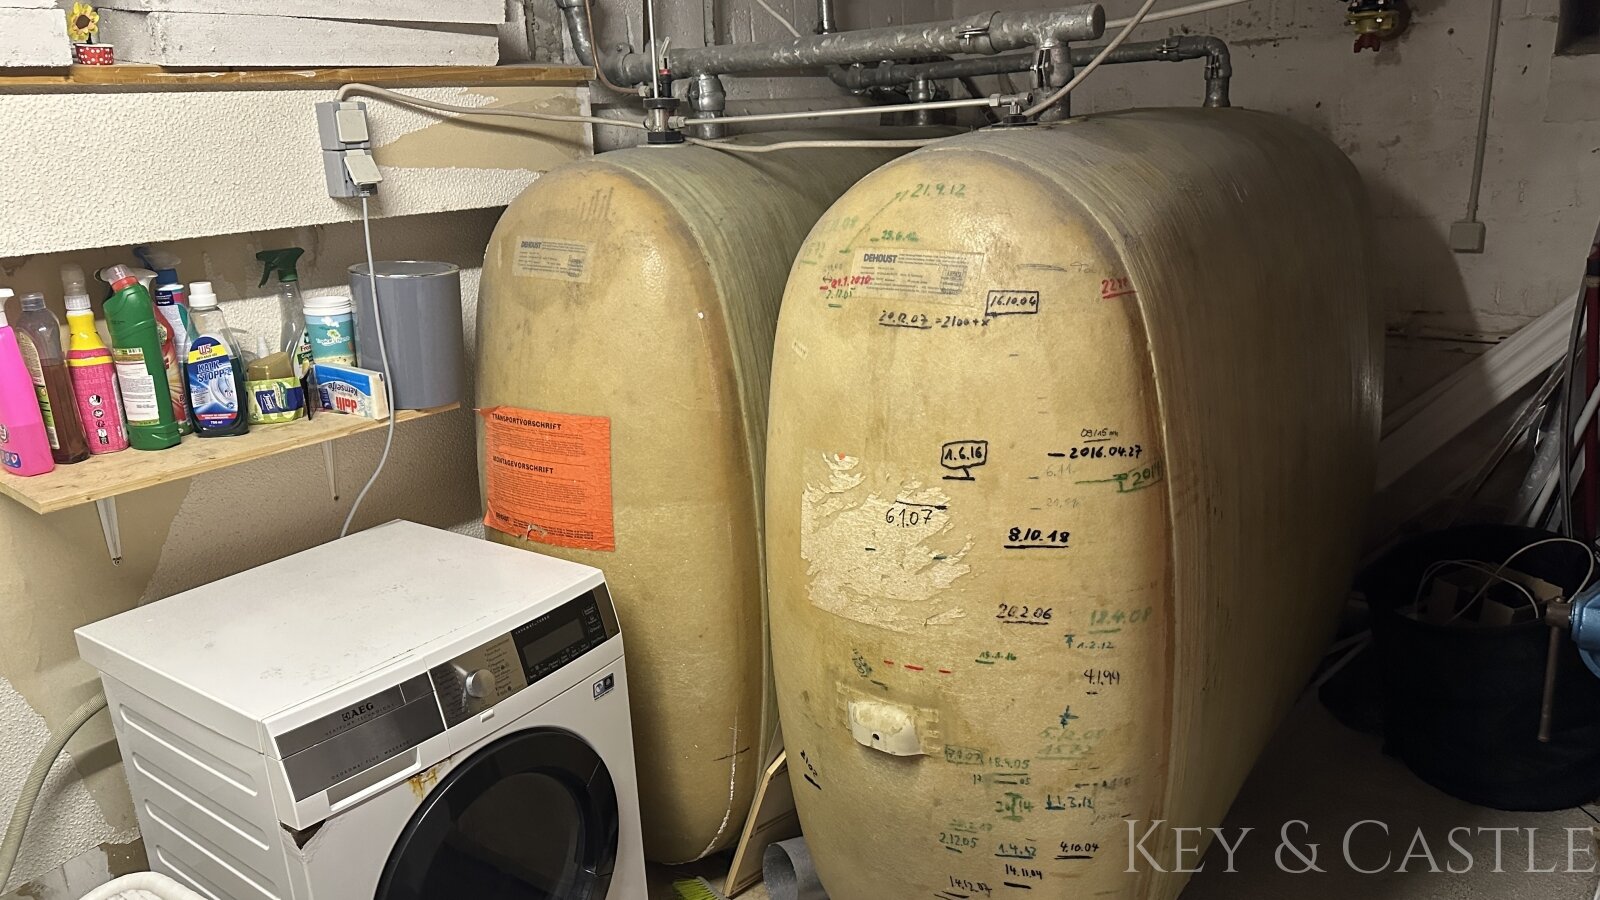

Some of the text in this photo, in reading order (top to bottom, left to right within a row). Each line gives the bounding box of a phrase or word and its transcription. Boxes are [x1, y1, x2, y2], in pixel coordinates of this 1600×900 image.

[863, 253, 898, 264] DEHOUST
[336, 397, 358, 414] dalli
[491, 413, 562, 430] TRANSPORTVORSCHRIFT
[1069, 445, 1142, 459] 2016.04.27
[492, 455, 554, 474] MONTAGEVORSCHRIFT
[349, 701, 374, 718] AEG
[1060, 841, 1100, 853] 4.10.04
[1005, 864, 1043, 881] 14.11.04
